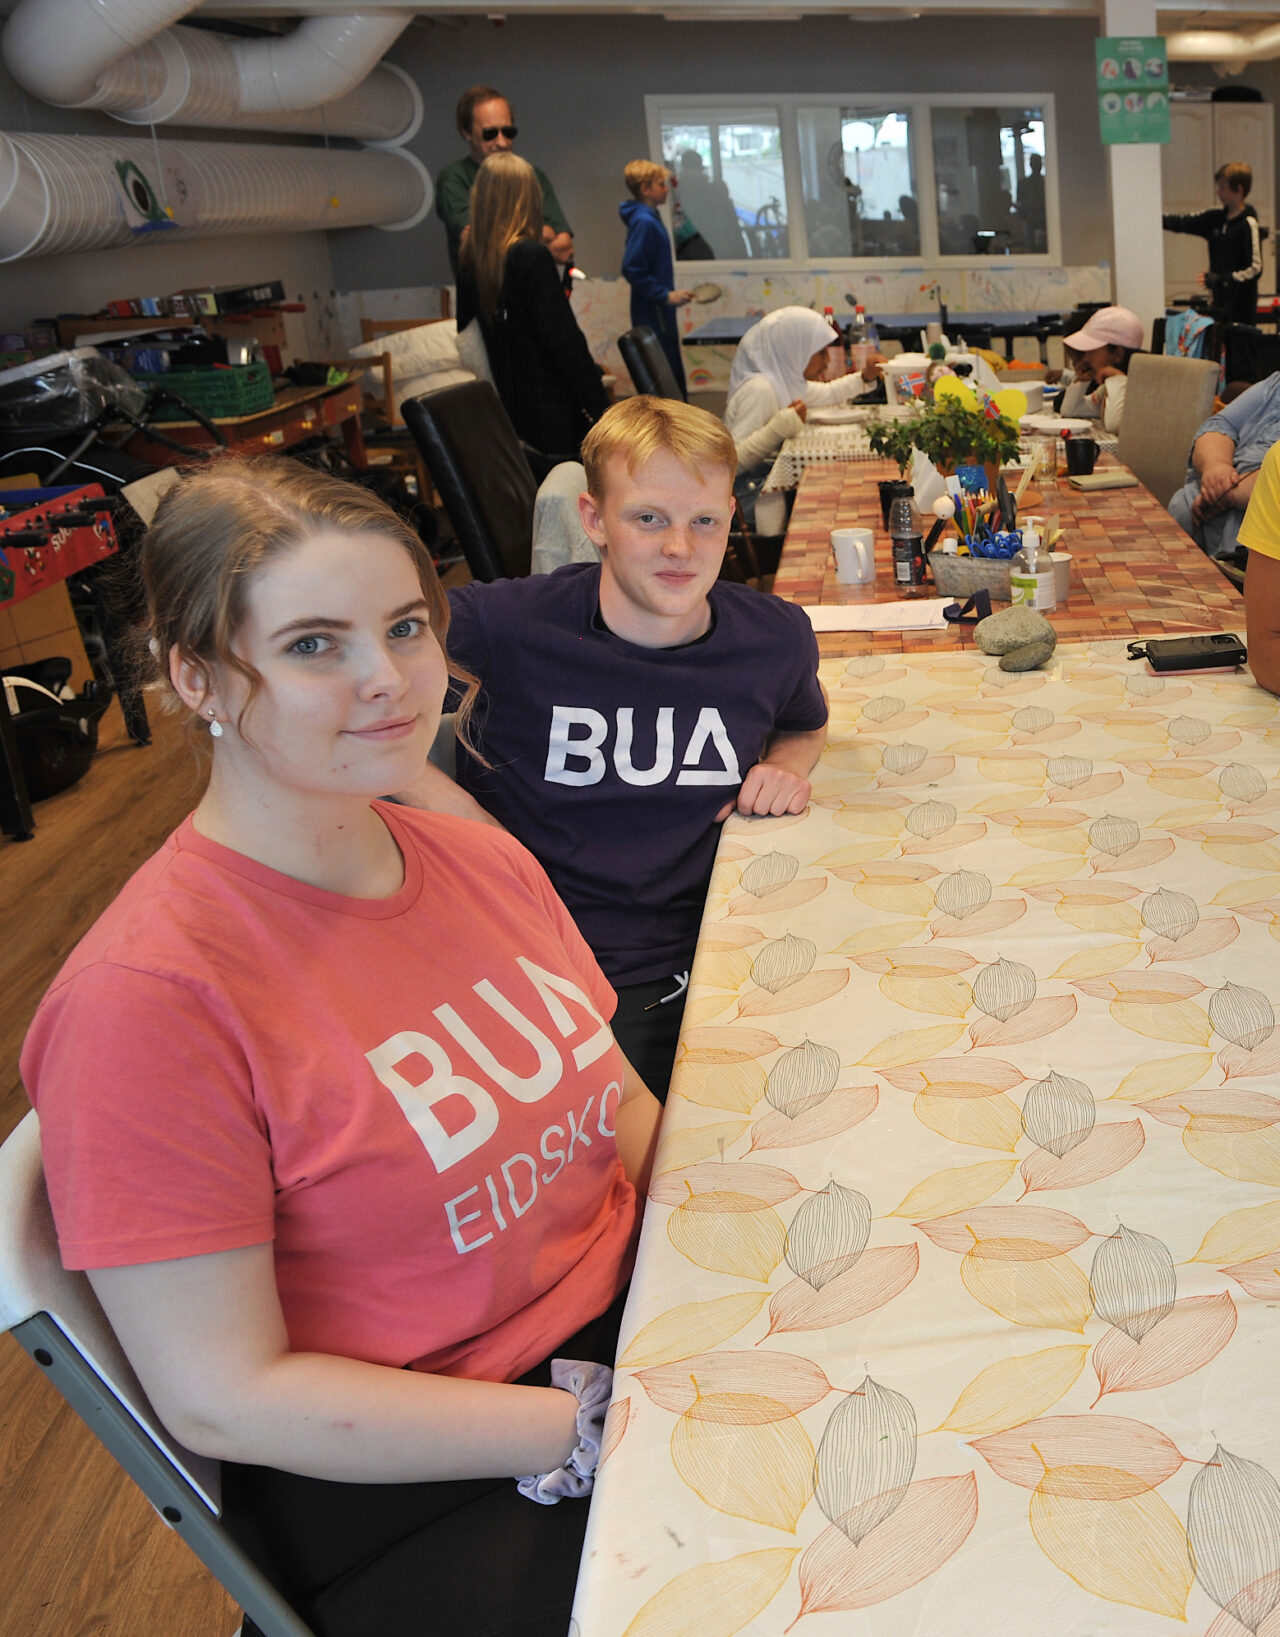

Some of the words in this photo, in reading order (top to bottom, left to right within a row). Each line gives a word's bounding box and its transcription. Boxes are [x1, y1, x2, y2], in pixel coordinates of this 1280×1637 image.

[544, 706, 742, 786] BUA
[365, 956, 613, 1173] BUA
[444, 1081, 620, 1254] EIDSKO
